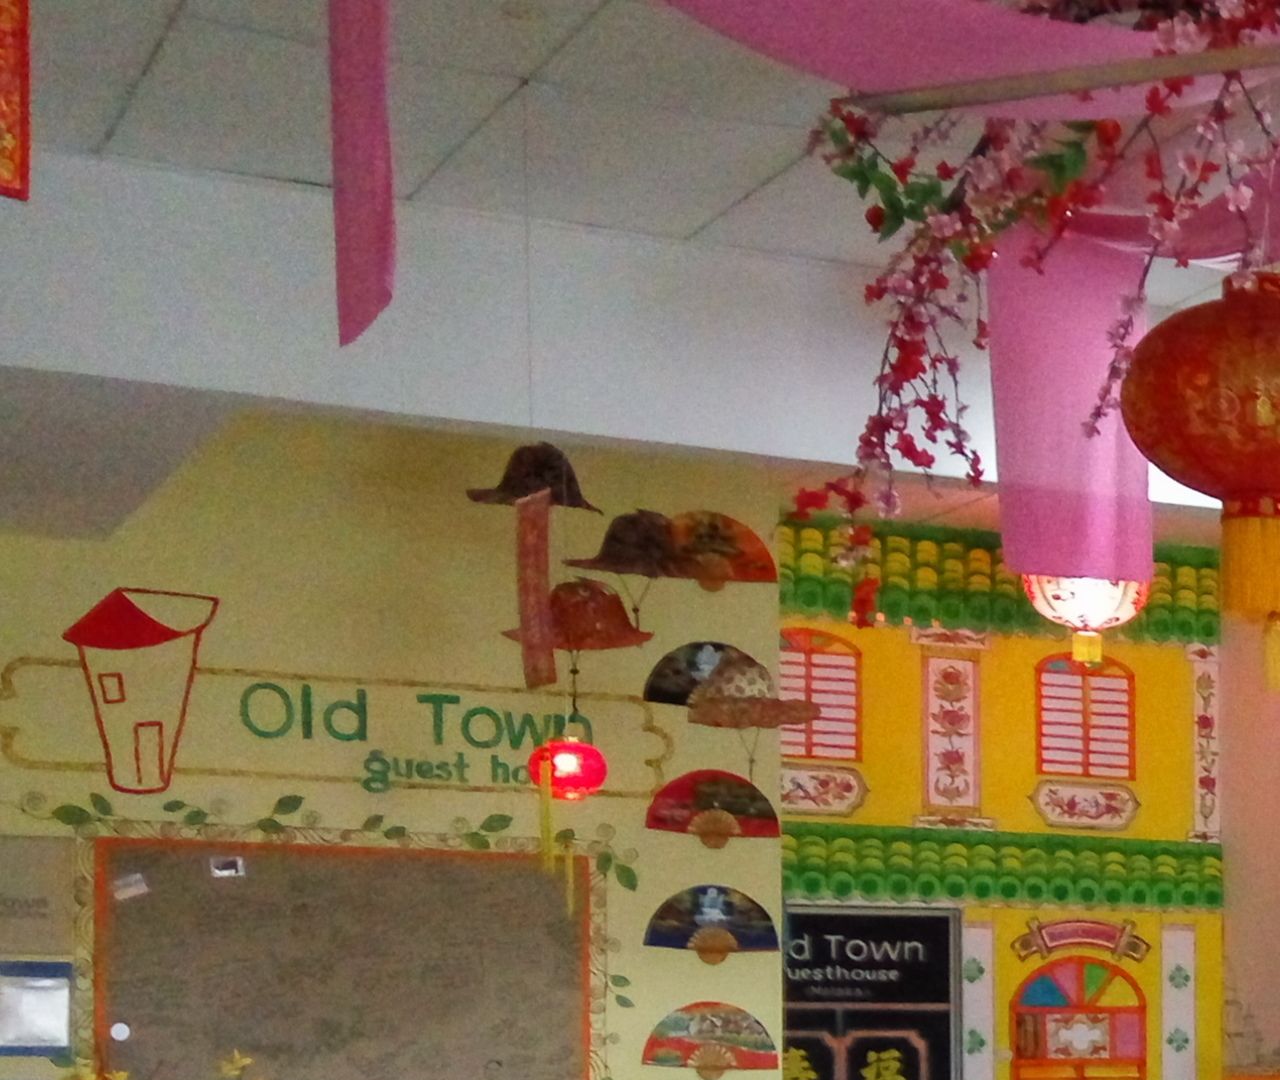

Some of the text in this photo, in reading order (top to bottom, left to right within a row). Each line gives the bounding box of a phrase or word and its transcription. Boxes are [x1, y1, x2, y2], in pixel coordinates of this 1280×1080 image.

[240, 682, 593, 750] Old Town
[362, 749, 470, 793] guest
[823, 934, 926, 962] Town
[785, 965, 899, 981] uesthouse
